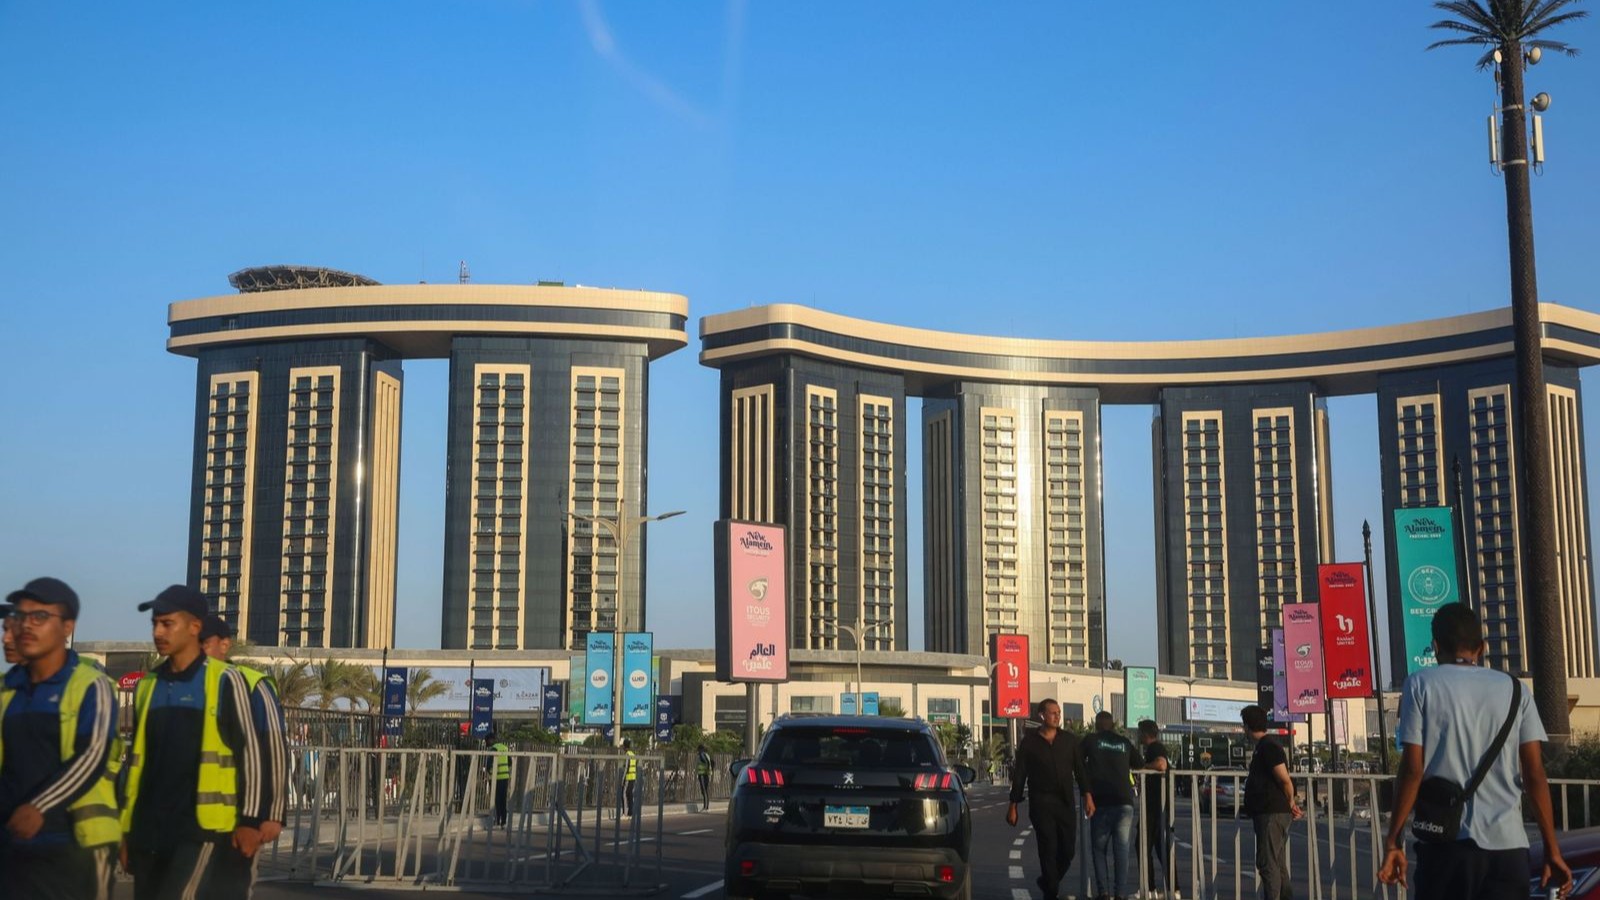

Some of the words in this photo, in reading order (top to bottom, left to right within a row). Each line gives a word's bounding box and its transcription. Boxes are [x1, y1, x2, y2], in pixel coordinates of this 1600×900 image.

[1413, 517, 1436, 527] New
[1404, 524, 1445, 534] Alamein
[747, 531, 767, 542] New
[739, 537, 773, 551] Alamein
[1412, 820, 1444, 834] adidas
